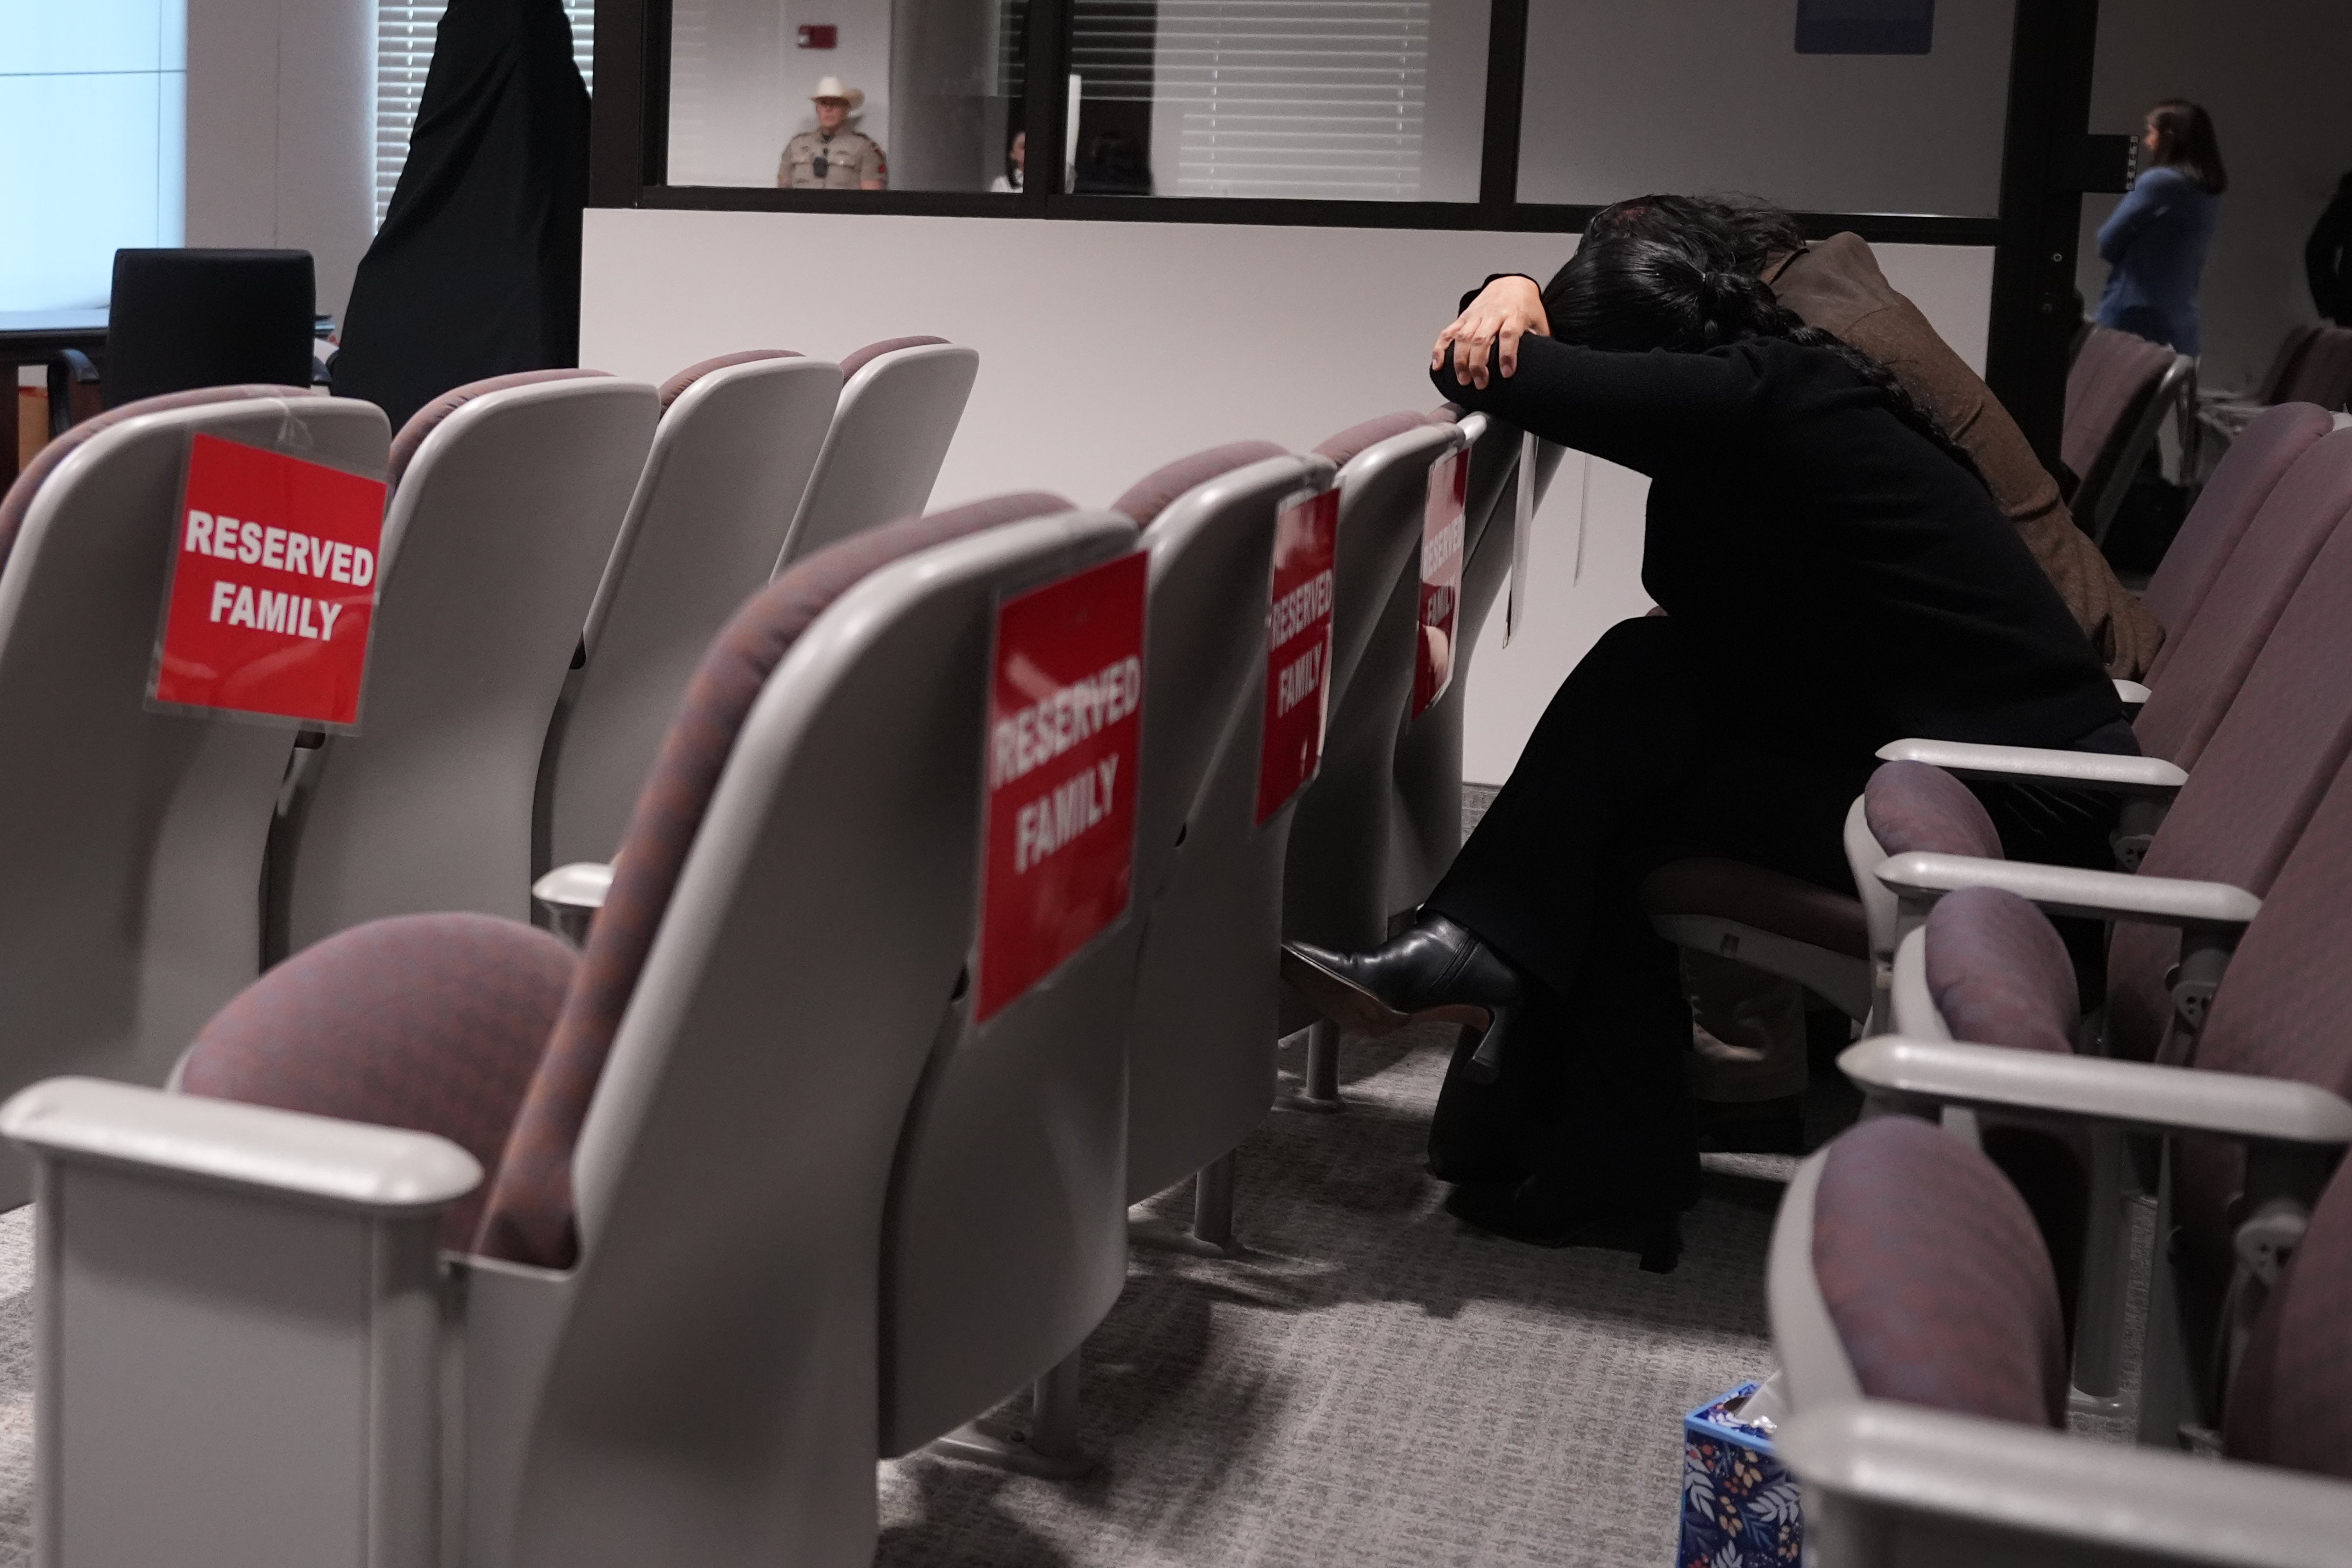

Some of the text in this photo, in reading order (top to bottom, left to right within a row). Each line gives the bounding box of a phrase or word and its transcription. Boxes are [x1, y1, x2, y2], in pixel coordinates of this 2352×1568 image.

[2127, 142, 2136, 184] PUSH
[185, 509, 374, 587] RESERVED
[210, 580, 342, 641] FAMILY
[1272, 569, 1333, 651] RESERVED
[1277, 642, 1322, 718] FAMILY
[990, 654, 1141, 791] RESERVED
[1015, 754, 1119, 875] FAMILY
